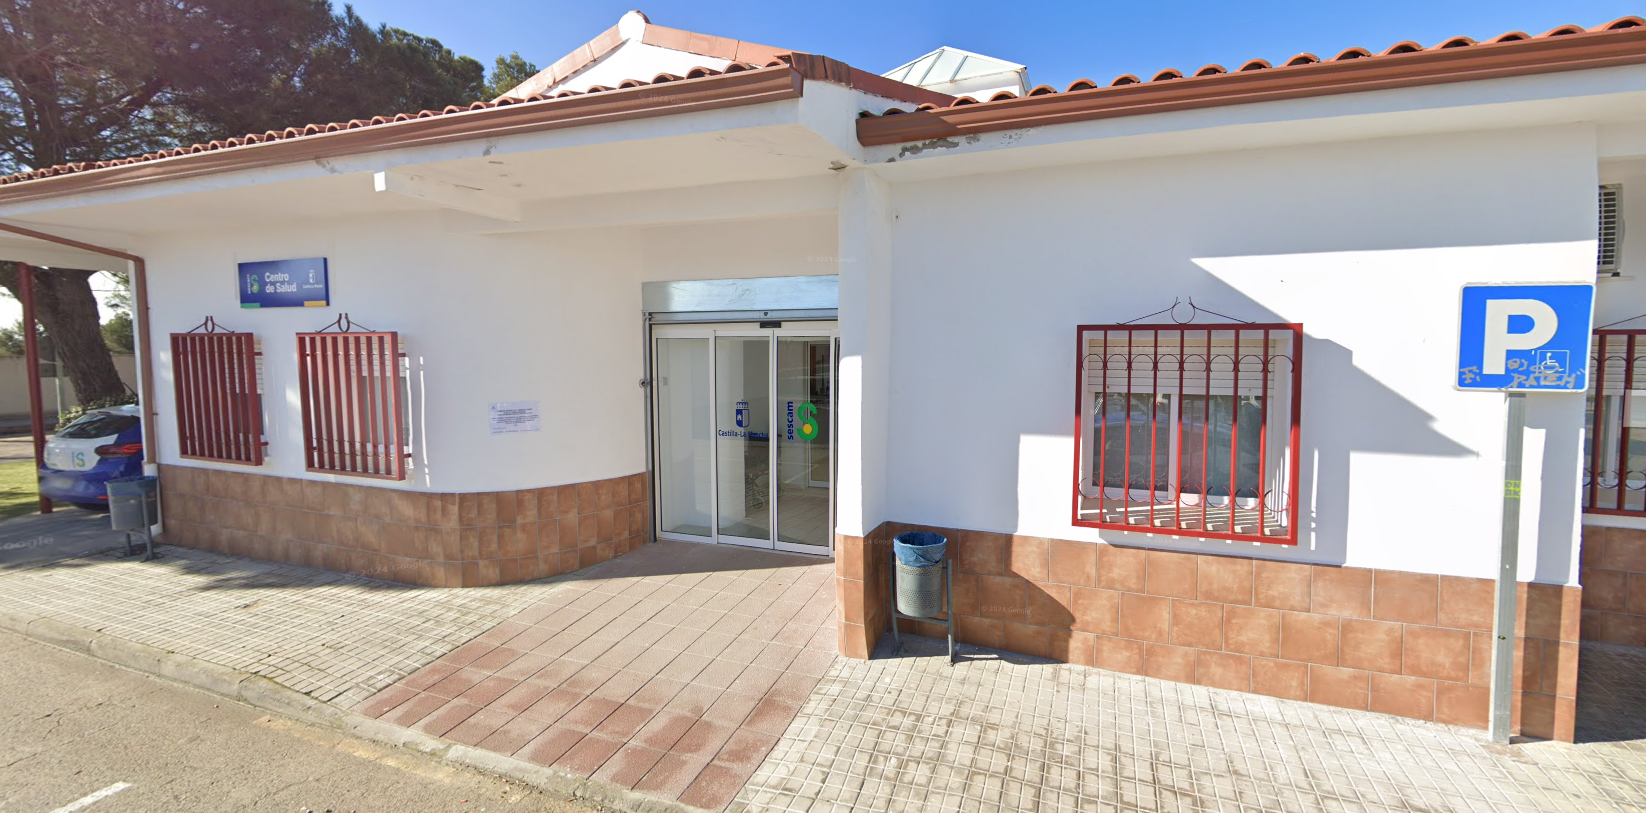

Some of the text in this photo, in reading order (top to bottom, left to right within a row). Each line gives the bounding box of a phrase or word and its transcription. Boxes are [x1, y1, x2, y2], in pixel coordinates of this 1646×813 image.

[264, 272, 289, 282] Centro
[265, 284, 275, 293] de
[276, 282, 297, 293] Salud
[1482, 299, 1558, 375] P
[786, 401, 794, 440] sescam
[718, 429, 747, 438] Castilla-La
